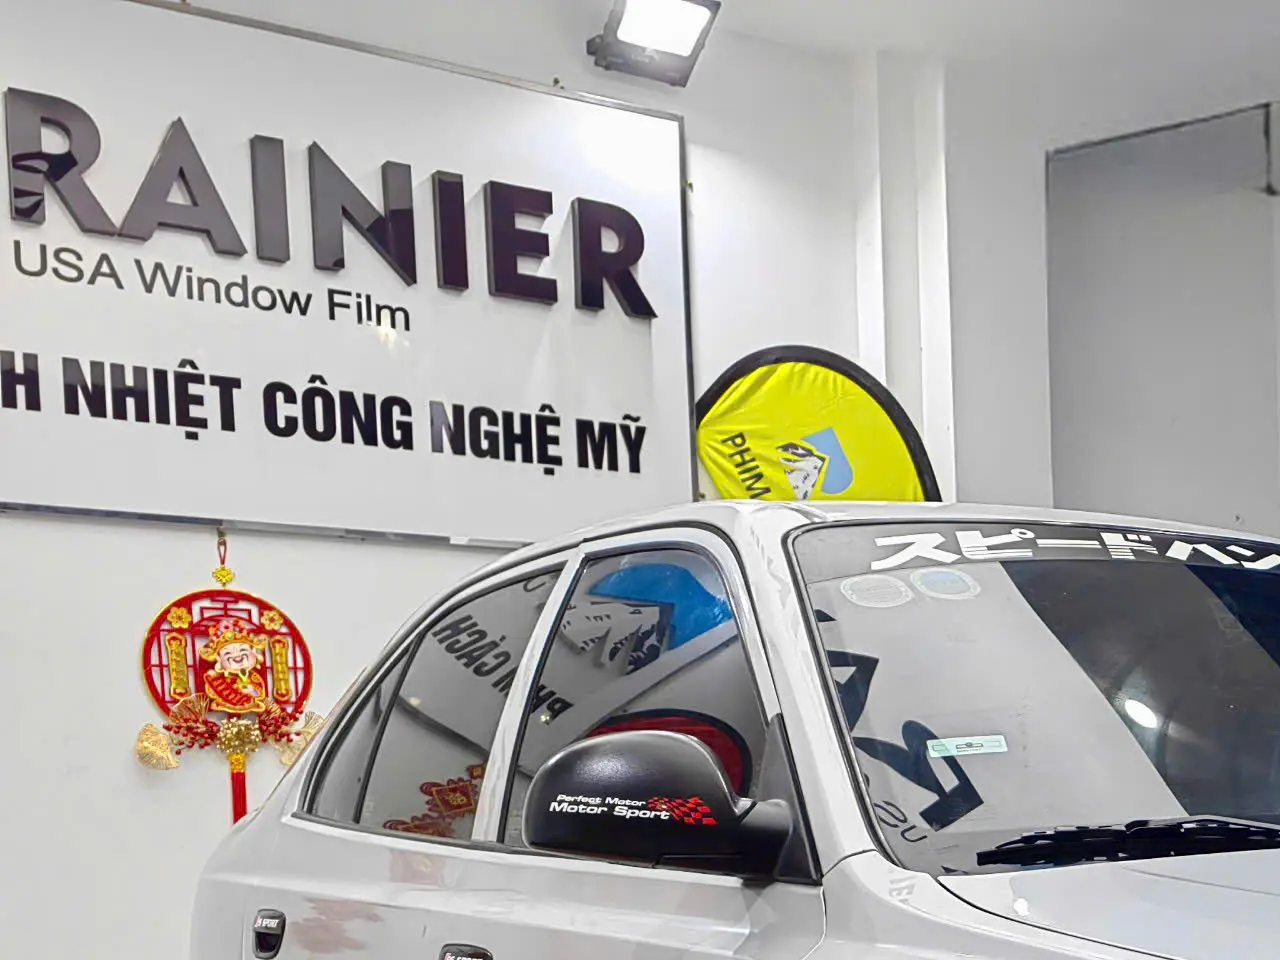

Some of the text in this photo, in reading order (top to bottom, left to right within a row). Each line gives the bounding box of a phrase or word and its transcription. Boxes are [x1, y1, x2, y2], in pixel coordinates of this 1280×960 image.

[5, 86, 658, 319] RAINIER
[13, 240, 411, 332] USA Window Film
[61, 357, 242, 442] NHIỆT
[262, 374, 413, 452] CÔNG
[429, 403, 562, 476] NGHỆ
[576, 413, 646, 474] MỸ
[721, 432, 771, 499] PHIM
[549, 802, 670, 820] Motor Sport
[557, 794, 646, 807] Perfect Motor
